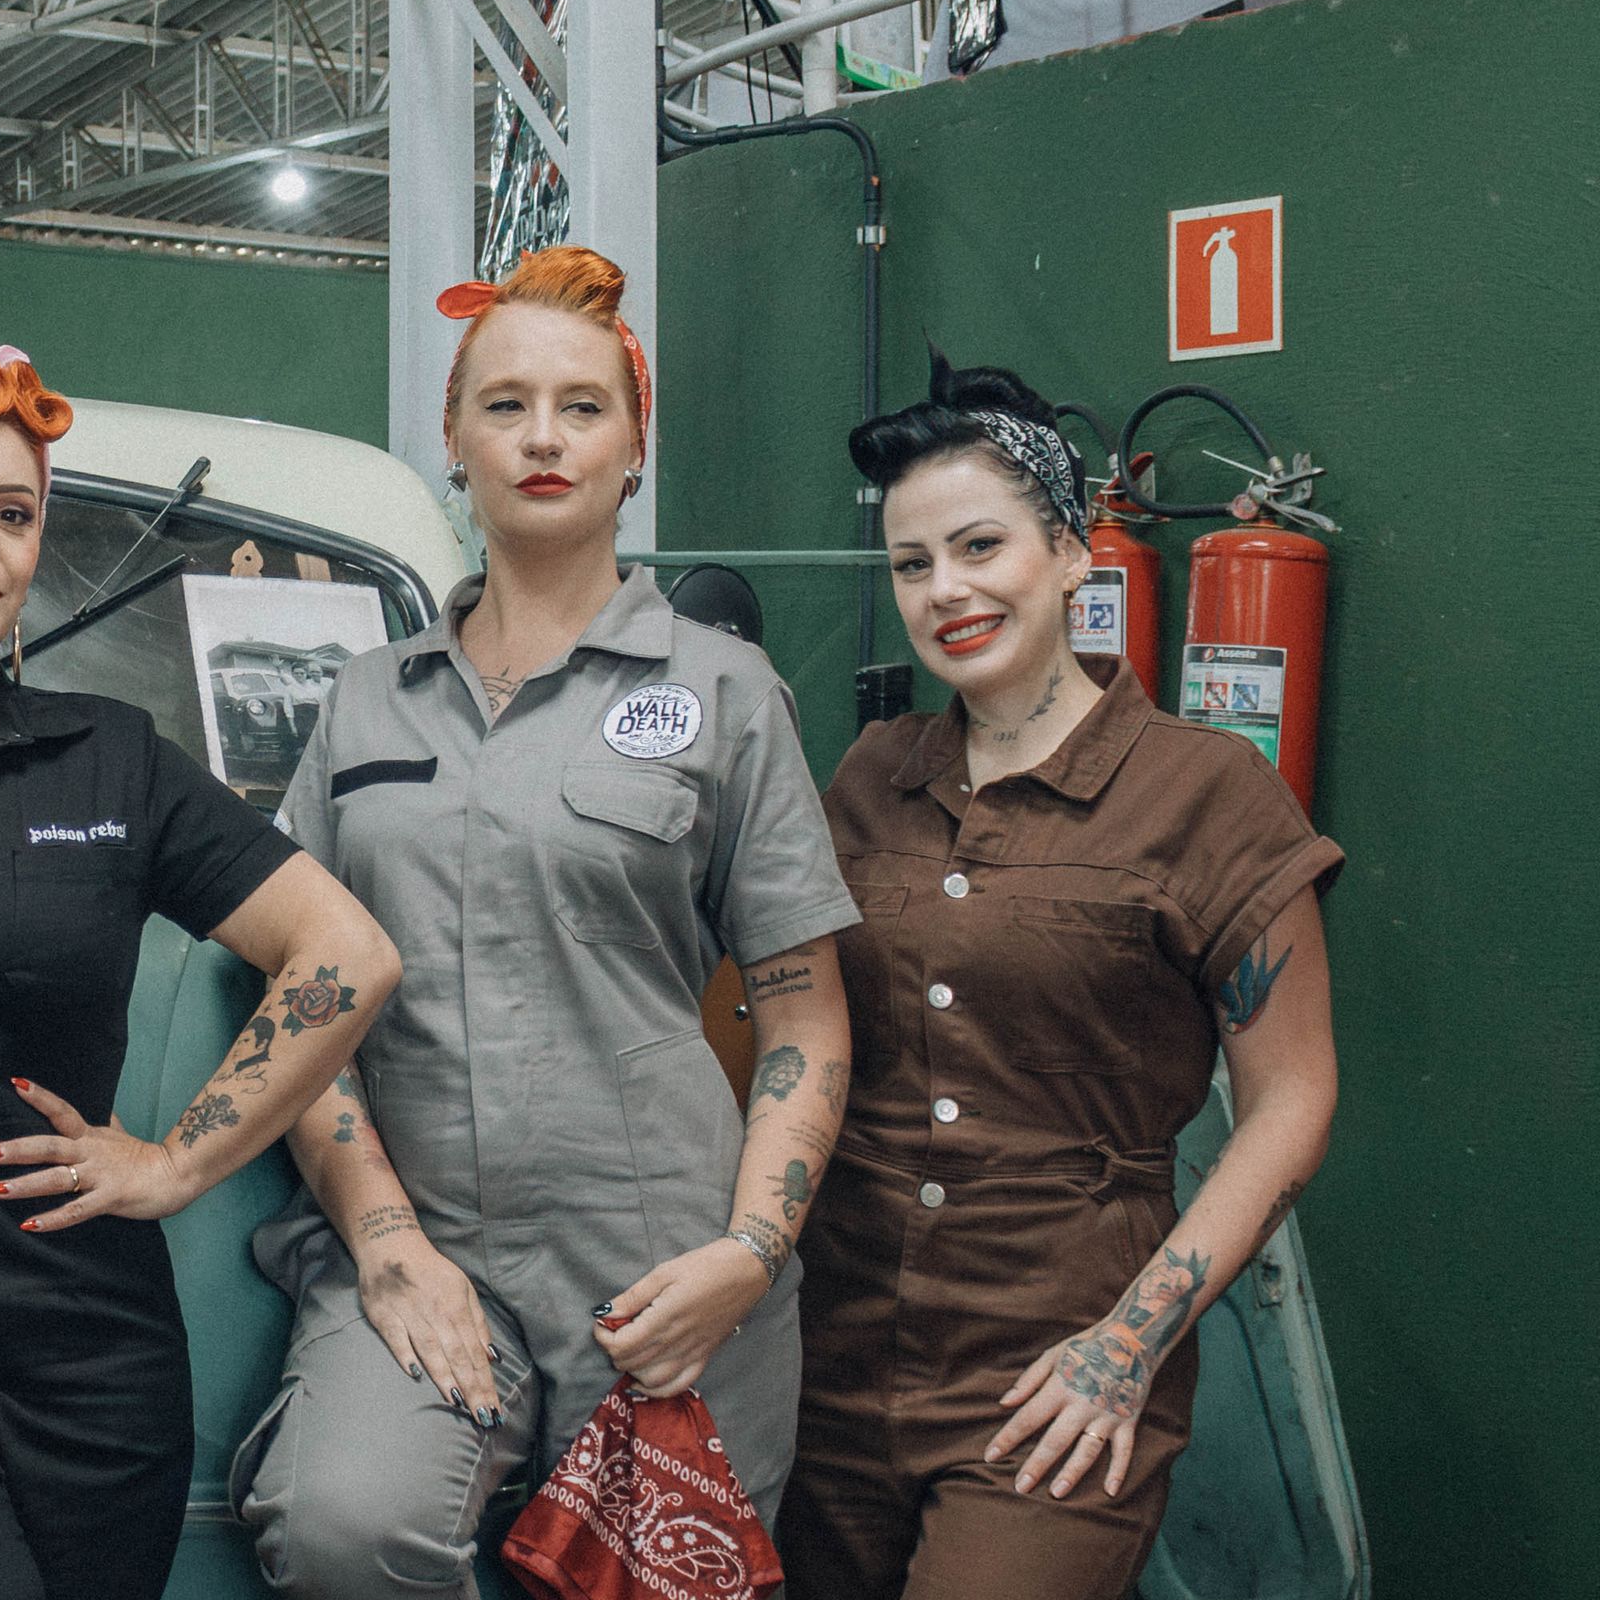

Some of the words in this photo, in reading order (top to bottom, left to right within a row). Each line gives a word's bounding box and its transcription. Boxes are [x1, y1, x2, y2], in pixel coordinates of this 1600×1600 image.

[626, 699, 681, 718] WALL
[615, 715, 689, 736] DEATH
[28, 824, 87, 844] poison
